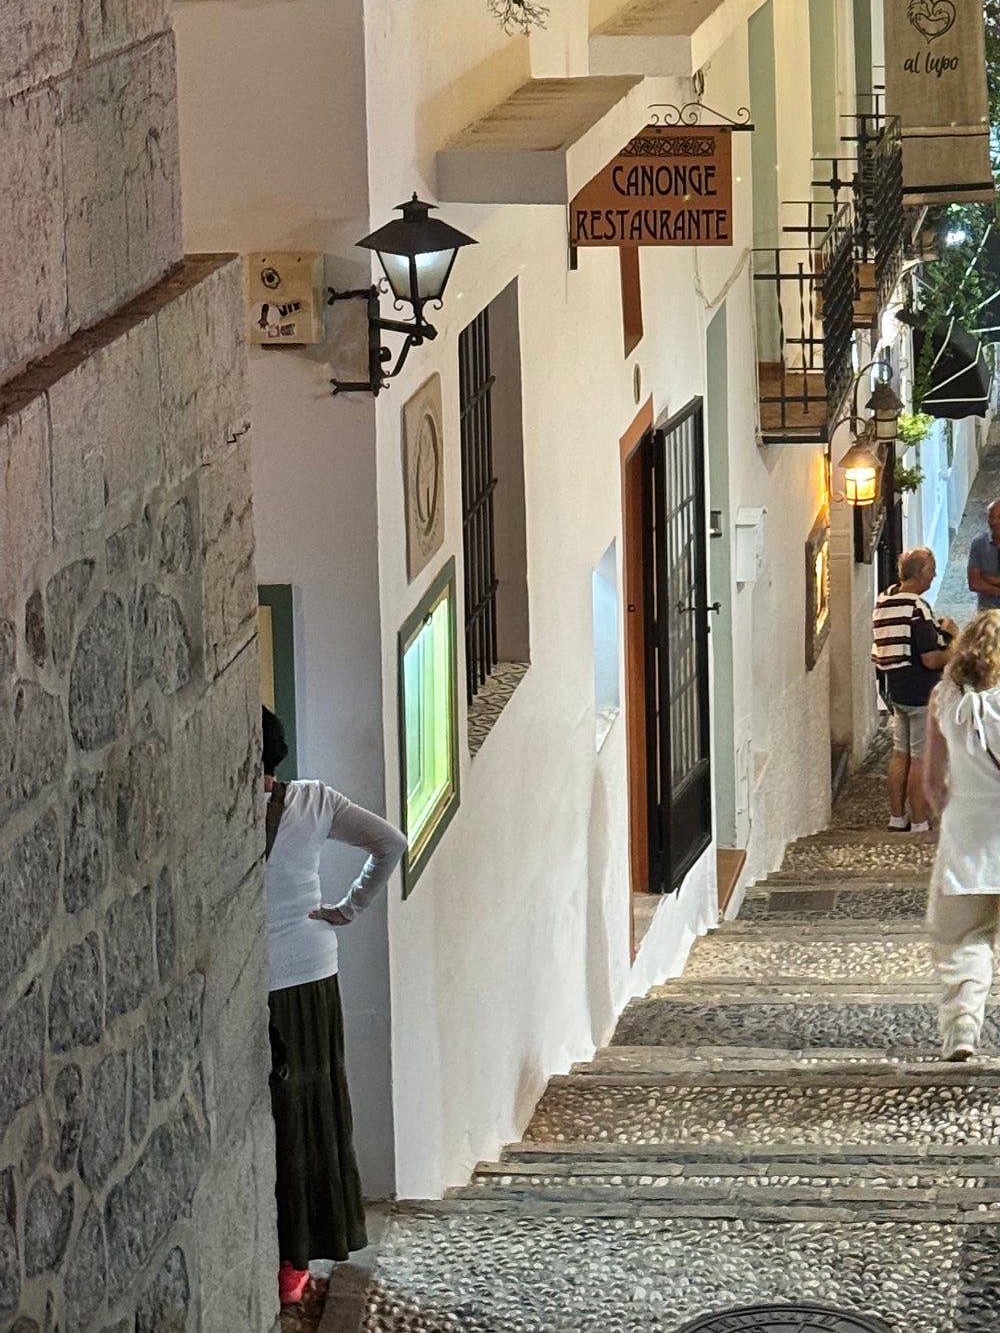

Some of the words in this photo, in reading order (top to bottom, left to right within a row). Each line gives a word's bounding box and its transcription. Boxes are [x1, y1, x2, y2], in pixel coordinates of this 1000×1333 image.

[903, 51, 920, 74] al
[925, 51, 959, 78] lupo
[611, 165, 717, 196] CANONGE
[576, 209, 728, 240] RESTAURANTE
